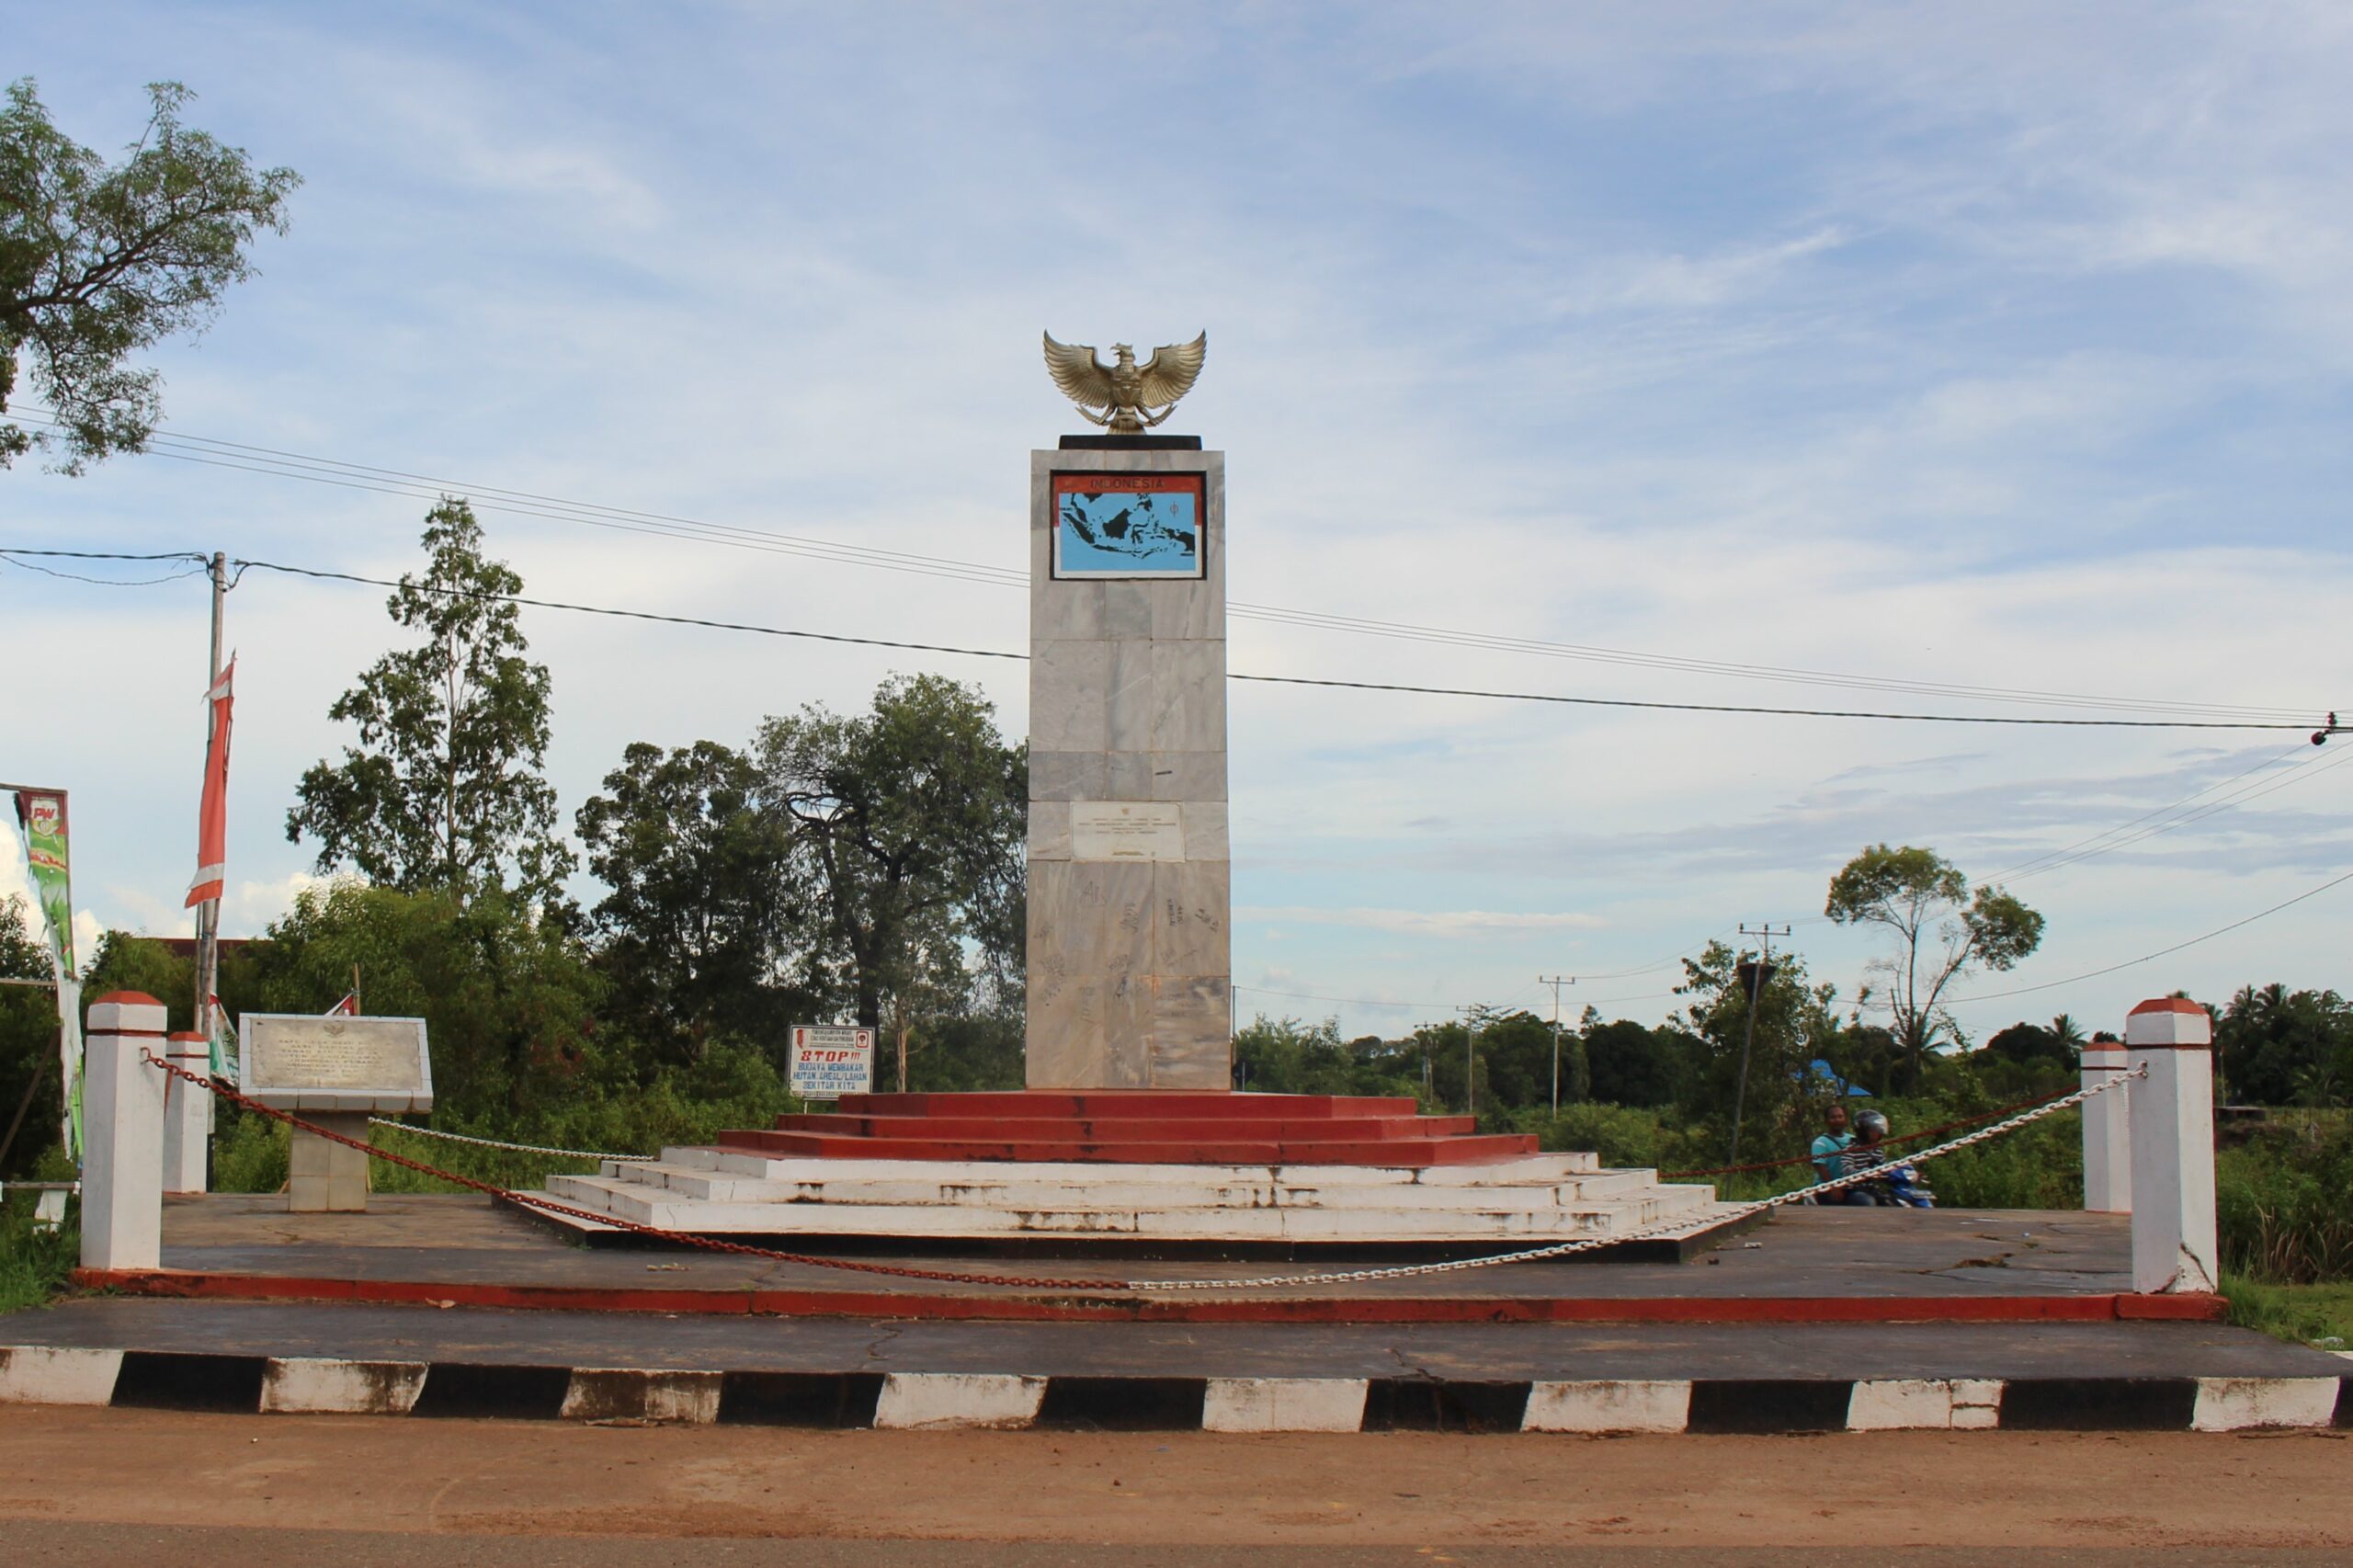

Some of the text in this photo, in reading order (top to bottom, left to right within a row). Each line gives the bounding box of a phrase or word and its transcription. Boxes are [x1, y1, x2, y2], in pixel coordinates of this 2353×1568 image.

[1090, 479, 1164, 489] INDONESIA
[801, 1051, 848, 1062] STOP
[798, 1062, 863, 1072] BUDAYA MEMBAKAR
[793, 1072, 816, 1080] HUTAN
[802, 1081, 856, 1090] SEKITAR KITA
